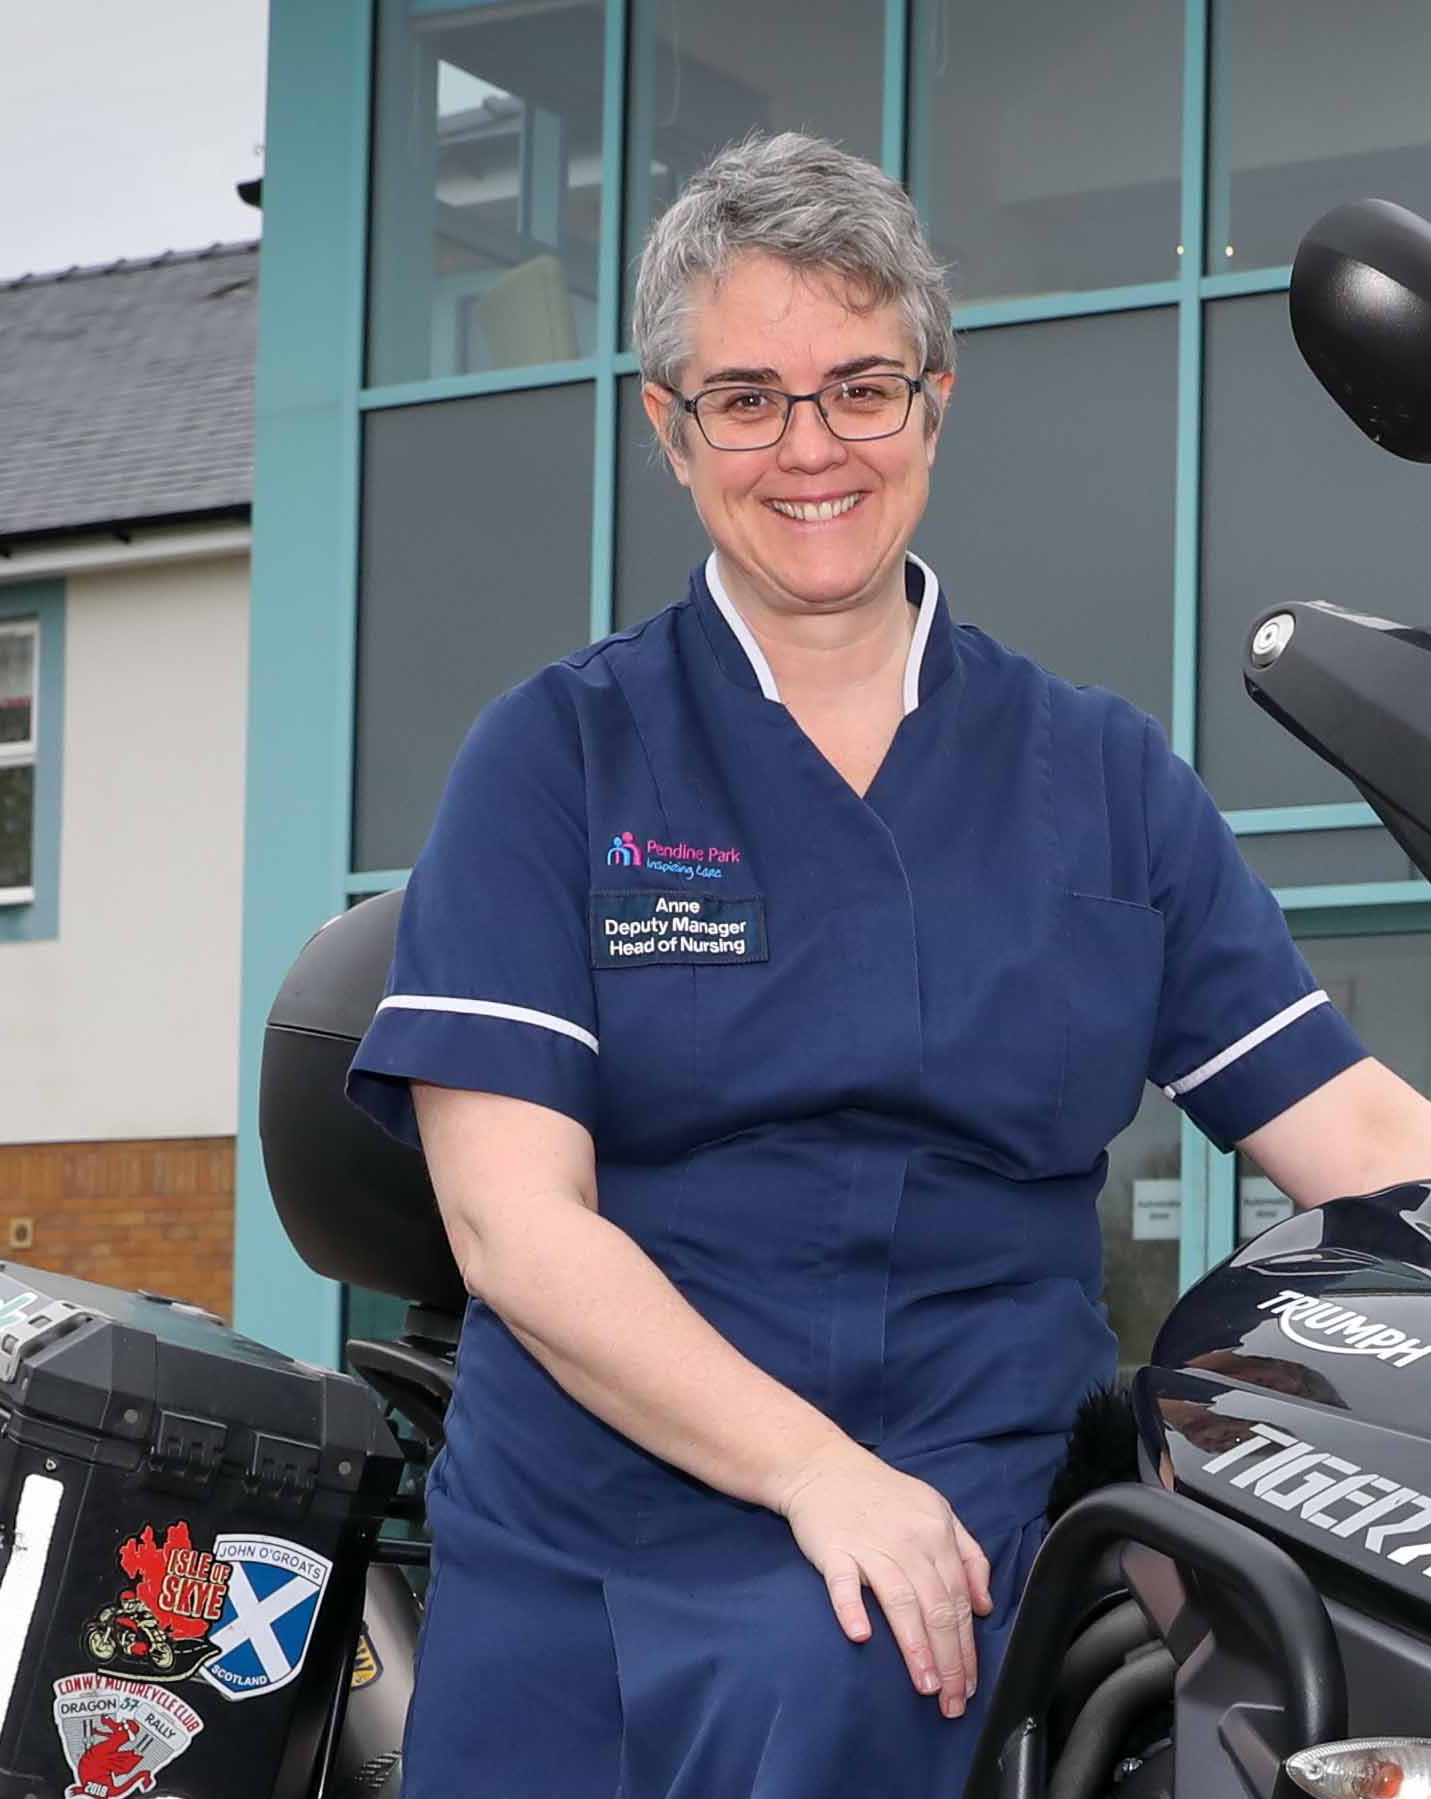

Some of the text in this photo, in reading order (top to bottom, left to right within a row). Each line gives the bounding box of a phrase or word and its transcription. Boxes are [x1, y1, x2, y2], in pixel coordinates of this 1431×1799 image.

[647, 839, 741, 864] Pendine Park
[655, 897, 700, 914] Anne
[605, 917, 746, 938] Deputy Manager
[610, 937, 746, 956] Head of Nursing
[169, 1548, 232, 1584] ISLE OF
[219, 1544, 322, 1580] JOHN O'GROATS
[157, 1575, 227, 1621] SKYE
[211, 1665, 268, 1686] SCOTLAND
[57, 1674, 201, 1734] CONWY MOTORCYCLE CLUB
[61, 1699, 117, 1715] DRAGON
[119, 1698, 140, 1712] 57
[144, 1713, 177, 1739] RALLY
